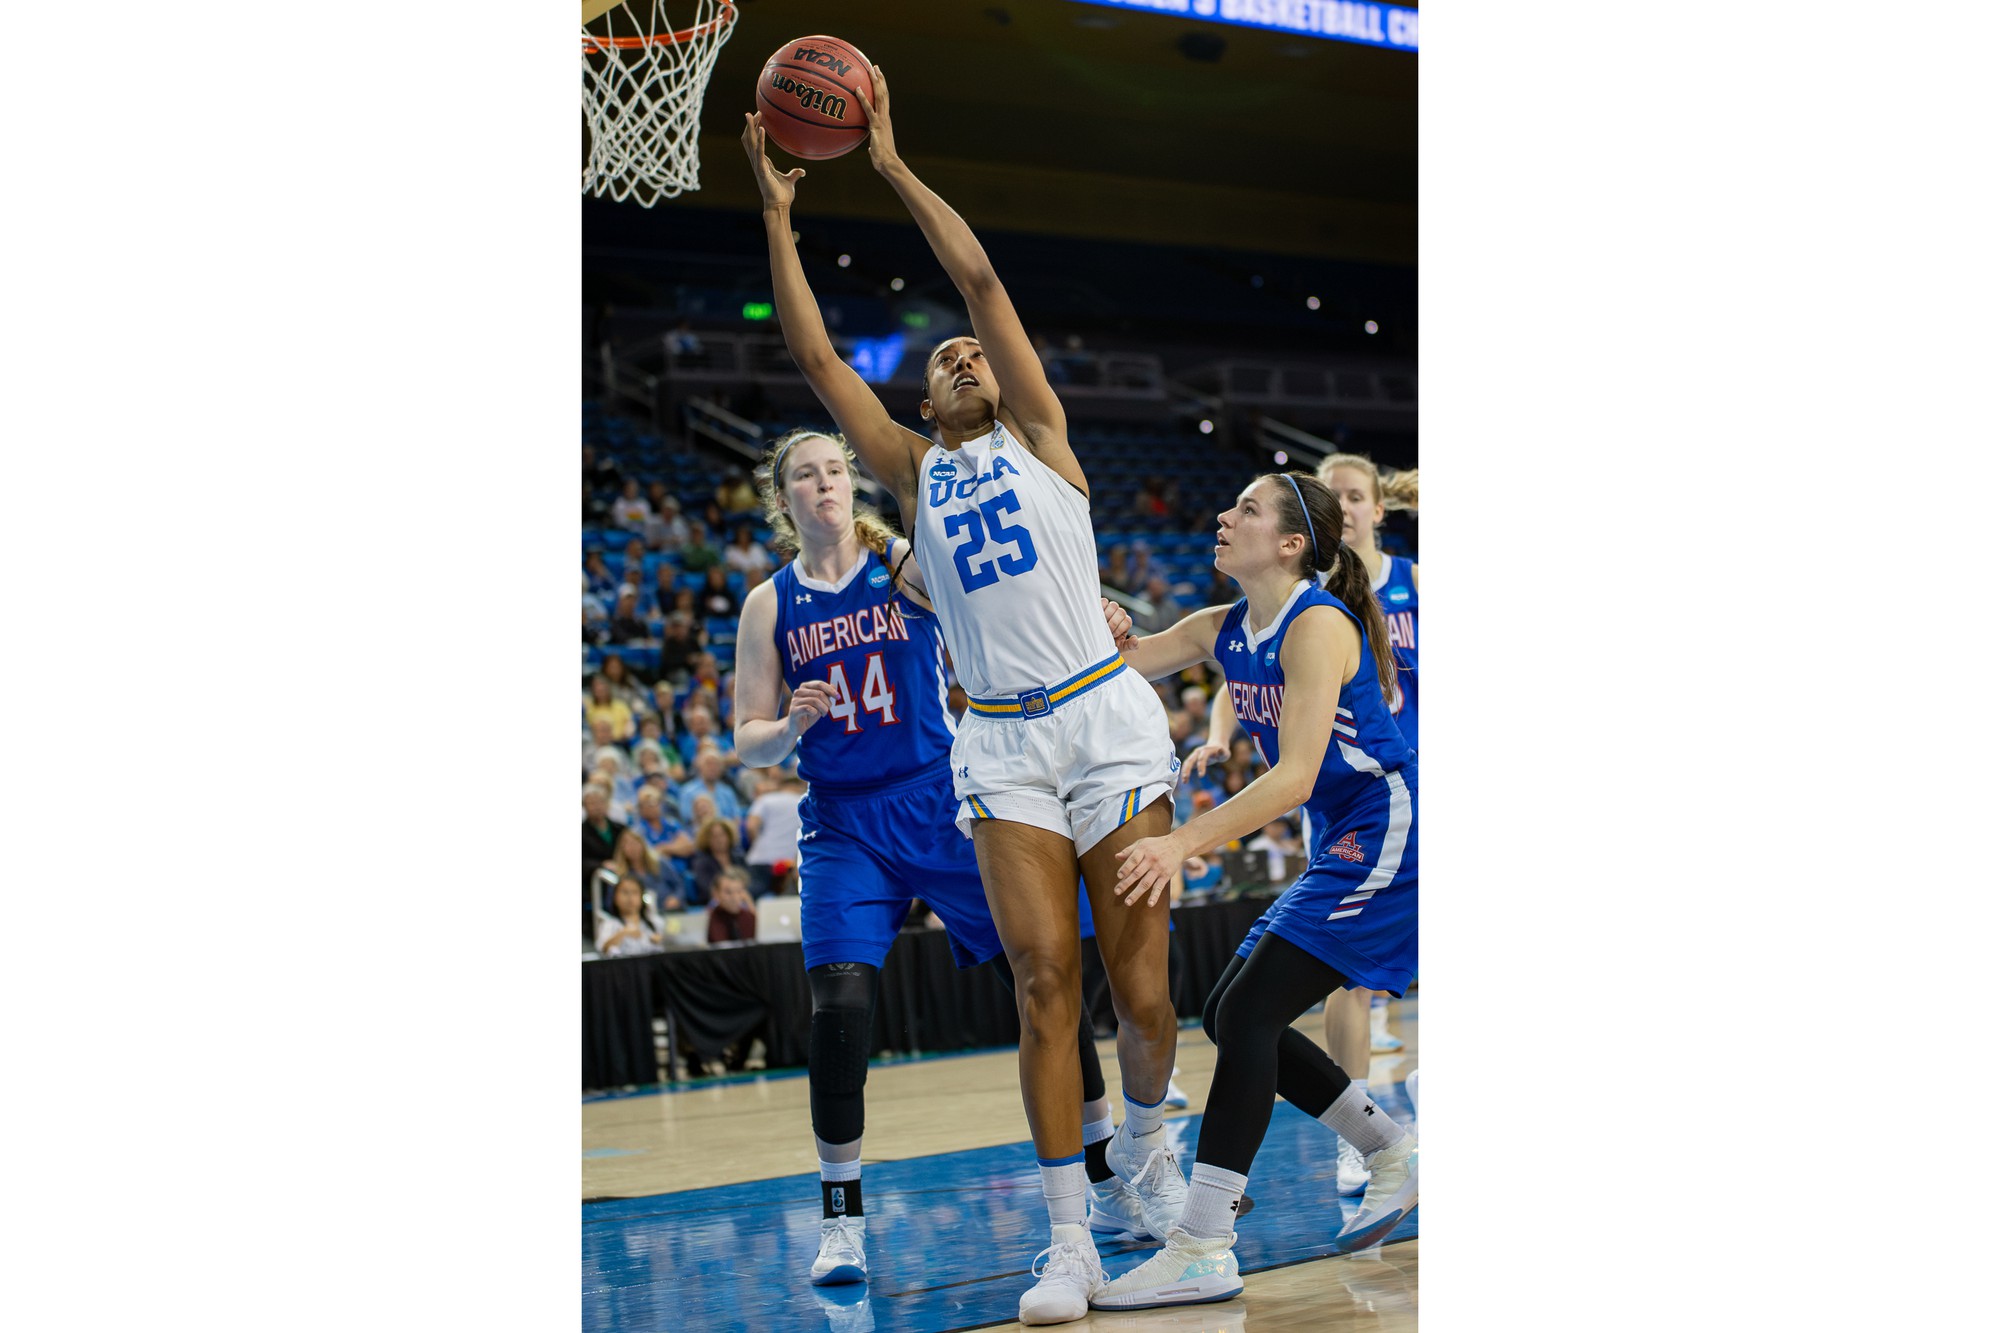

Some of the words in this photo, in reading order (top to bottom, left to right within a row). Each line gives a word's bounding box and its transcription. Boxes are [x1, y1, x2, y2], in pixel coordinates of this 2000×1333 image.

[793, 47, 852, 78] NCAA
[772, 72, 848, 121] Wilson
[943, 489, 1038, 594] 25
[786, 601, 910, 673] AMERICAN
[826, 652, 901, 735] 44
[1330, 847, 1363, 860] AMERICAN
